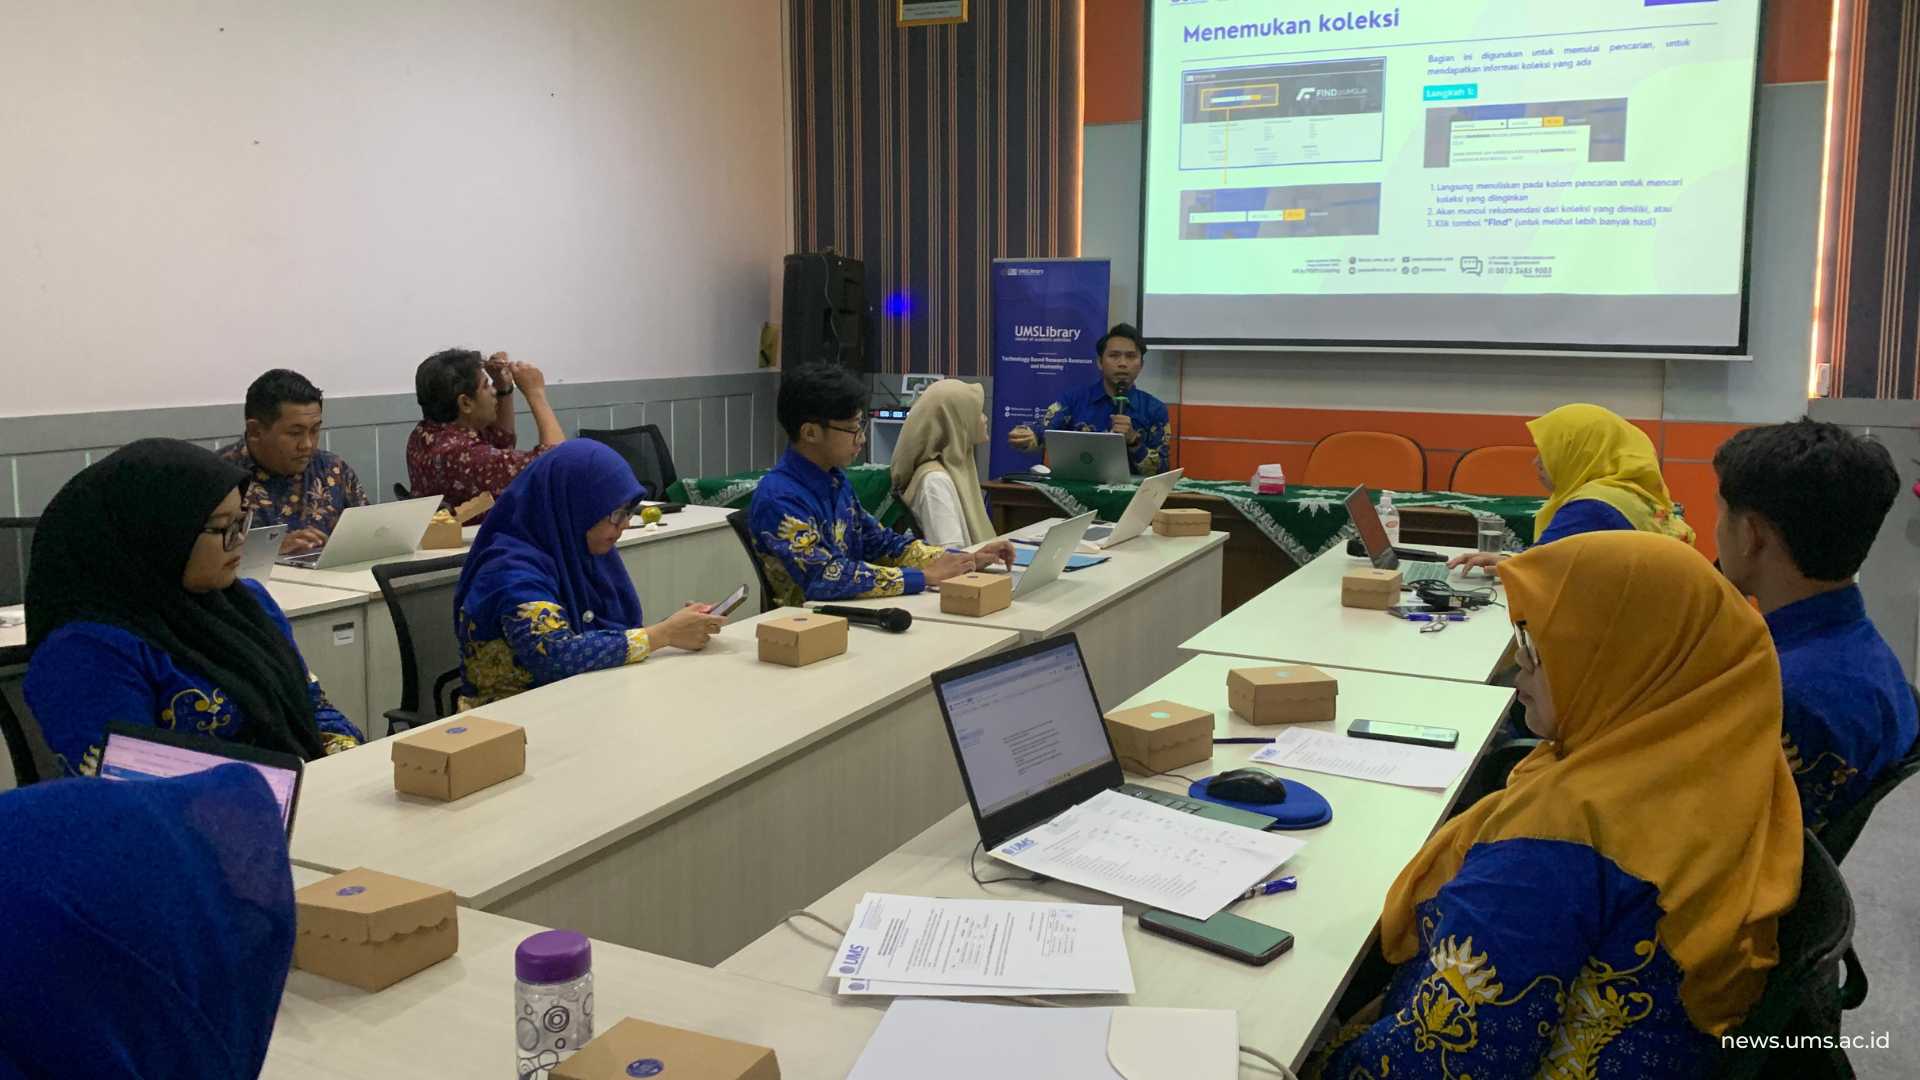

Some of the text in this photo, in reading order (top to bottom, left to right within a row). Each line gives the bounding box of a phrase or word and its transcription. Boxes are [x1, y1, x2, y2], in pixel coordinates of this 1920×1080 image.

[1184, 8, 1399, 43] Menemukan koleksi
[1428, 54, 1455, 64] Bagian
[1464, 52, 1473, 60] ini
[1481, 50, 1523, 60] digunakan
[1532, 48, 1554, 56] untuk
[1564, 45, 1599, 54] memulai
[1665, 38, 1690, 47] untuk
[1427, 57, 1592, 76] mendapatkan informasi koleksi yang ada
[1426, 87, 1465, 99] Langkah
[1437, 183, 1474, 192] Langsung
[1476, 182, 1520, 190] menuliskan
[1522, 180, 1544, 190] pada
[1546, 180, 1572, 188] kolom
[1575, 179, 1617, 188] pencarian
[1620, 178, 1643, 187] untuk
[1646, 178, 1683, 187] mencari
[1437, 194, 1528, 204] koleksi yang diinginkan
[1437, 207, 1455, 215] Akan
[1457, 207, 1486, 215] muncul
[1489, 206, 1540, 215] rekomendasi
[1542, 205, 1560, 214] dari
[1561, 205, 1591, 213] koleksi
[1593, 205, 1614, 215] yang
[1653, 205, 1672, 213] atau
[1452, 218, 1482, 227] tombol
[1542, 217, 1573, 226] melihat
[1575, 216, 1597, 225] lebih
[1599, 216, 1630, 227] banyak
[1015, 325, 1081, 340] UMSLibrary
[842, 944, 865, 965] UMS
